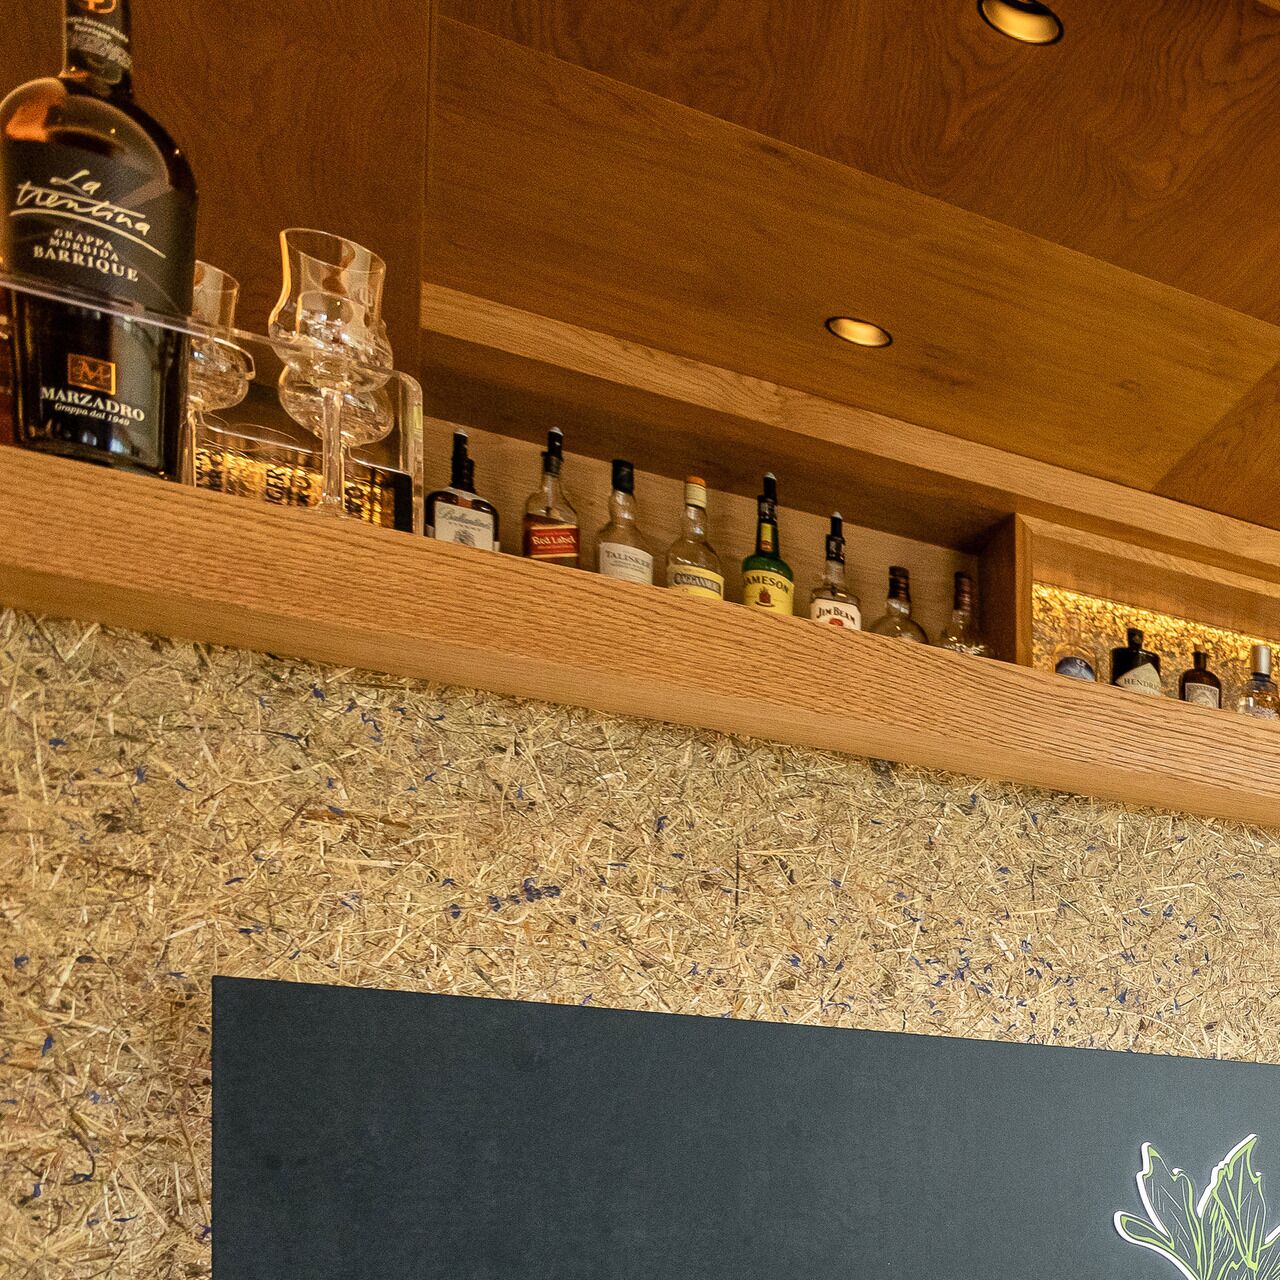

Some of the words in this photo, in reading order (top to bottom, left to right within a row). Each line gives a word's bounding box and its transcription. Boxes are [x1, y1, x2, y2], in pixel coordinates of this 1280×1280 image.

[50, 168, 102, 199] La
[49, 238, 120, 262] MORBIDA
[53, 228, 114, 251] GRAPPA
[33, 245, 140, 283] BARRIQUE
[39, 386, 146, 422] MARZADRO
[54, 402, 88, 417] Grappa
[531, 535, 551, 545] Red
[550, 535, 577, 545] Label
[816, 607, 832, 619] JIM
[832, 606, 856, 625] BEAM
